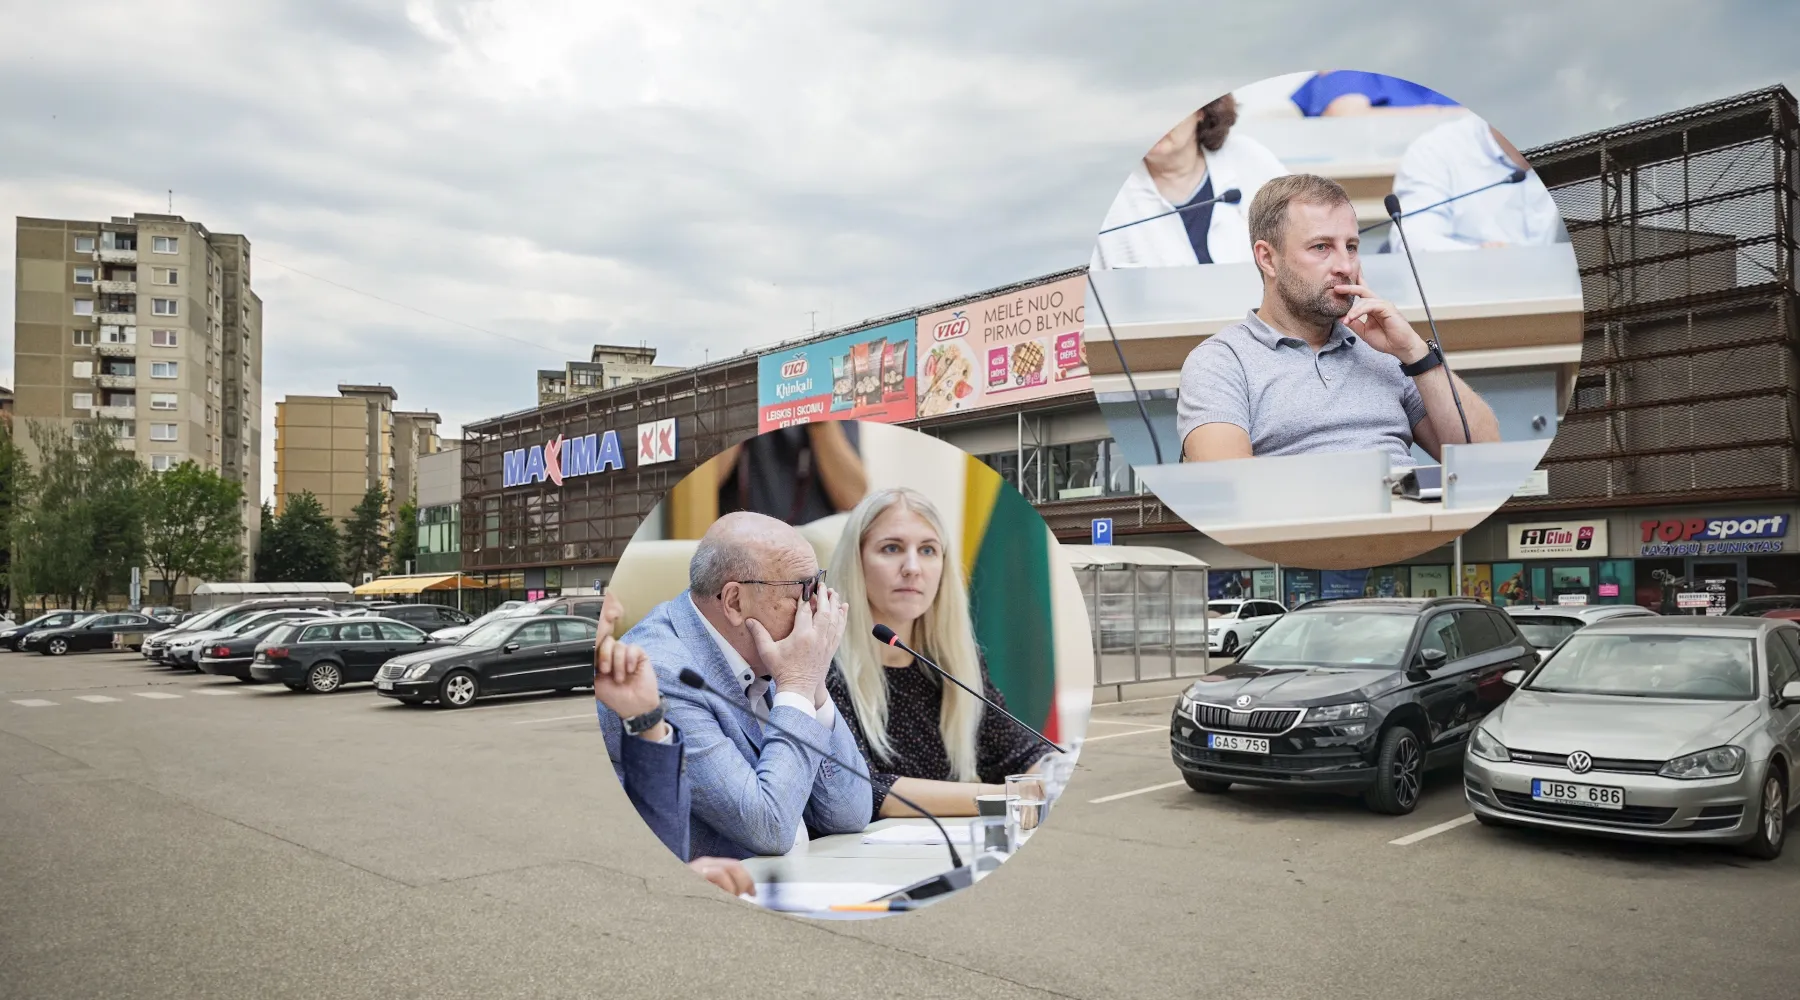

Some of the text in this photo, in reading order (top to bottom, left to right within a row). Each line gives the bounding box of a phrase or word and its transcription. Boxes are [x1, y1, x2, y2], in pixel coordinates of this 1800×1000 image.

[984, 291, 1063, 324] MEILĖ NUO
[937, 320, 966, 339] VICI
[984, 318, 1032, 344] PIRMO
[783, 361, 806, 377] VICI
[776, 378, 813, 399] Khinkali
[766, 407, 792, 422] LEISKIS
[503, 430, 624, 487] MAXIMA
[1097, 522, 1108, 539] P
[1580, 529, 1592, 537] 24
[1705, 540, 1783, 554] PUNKTAS
[1214, 736, 1268, 752] GAS 759
[1543, 783, 1577, 799] JBS
[1589, 787, 1621, 804] 686
